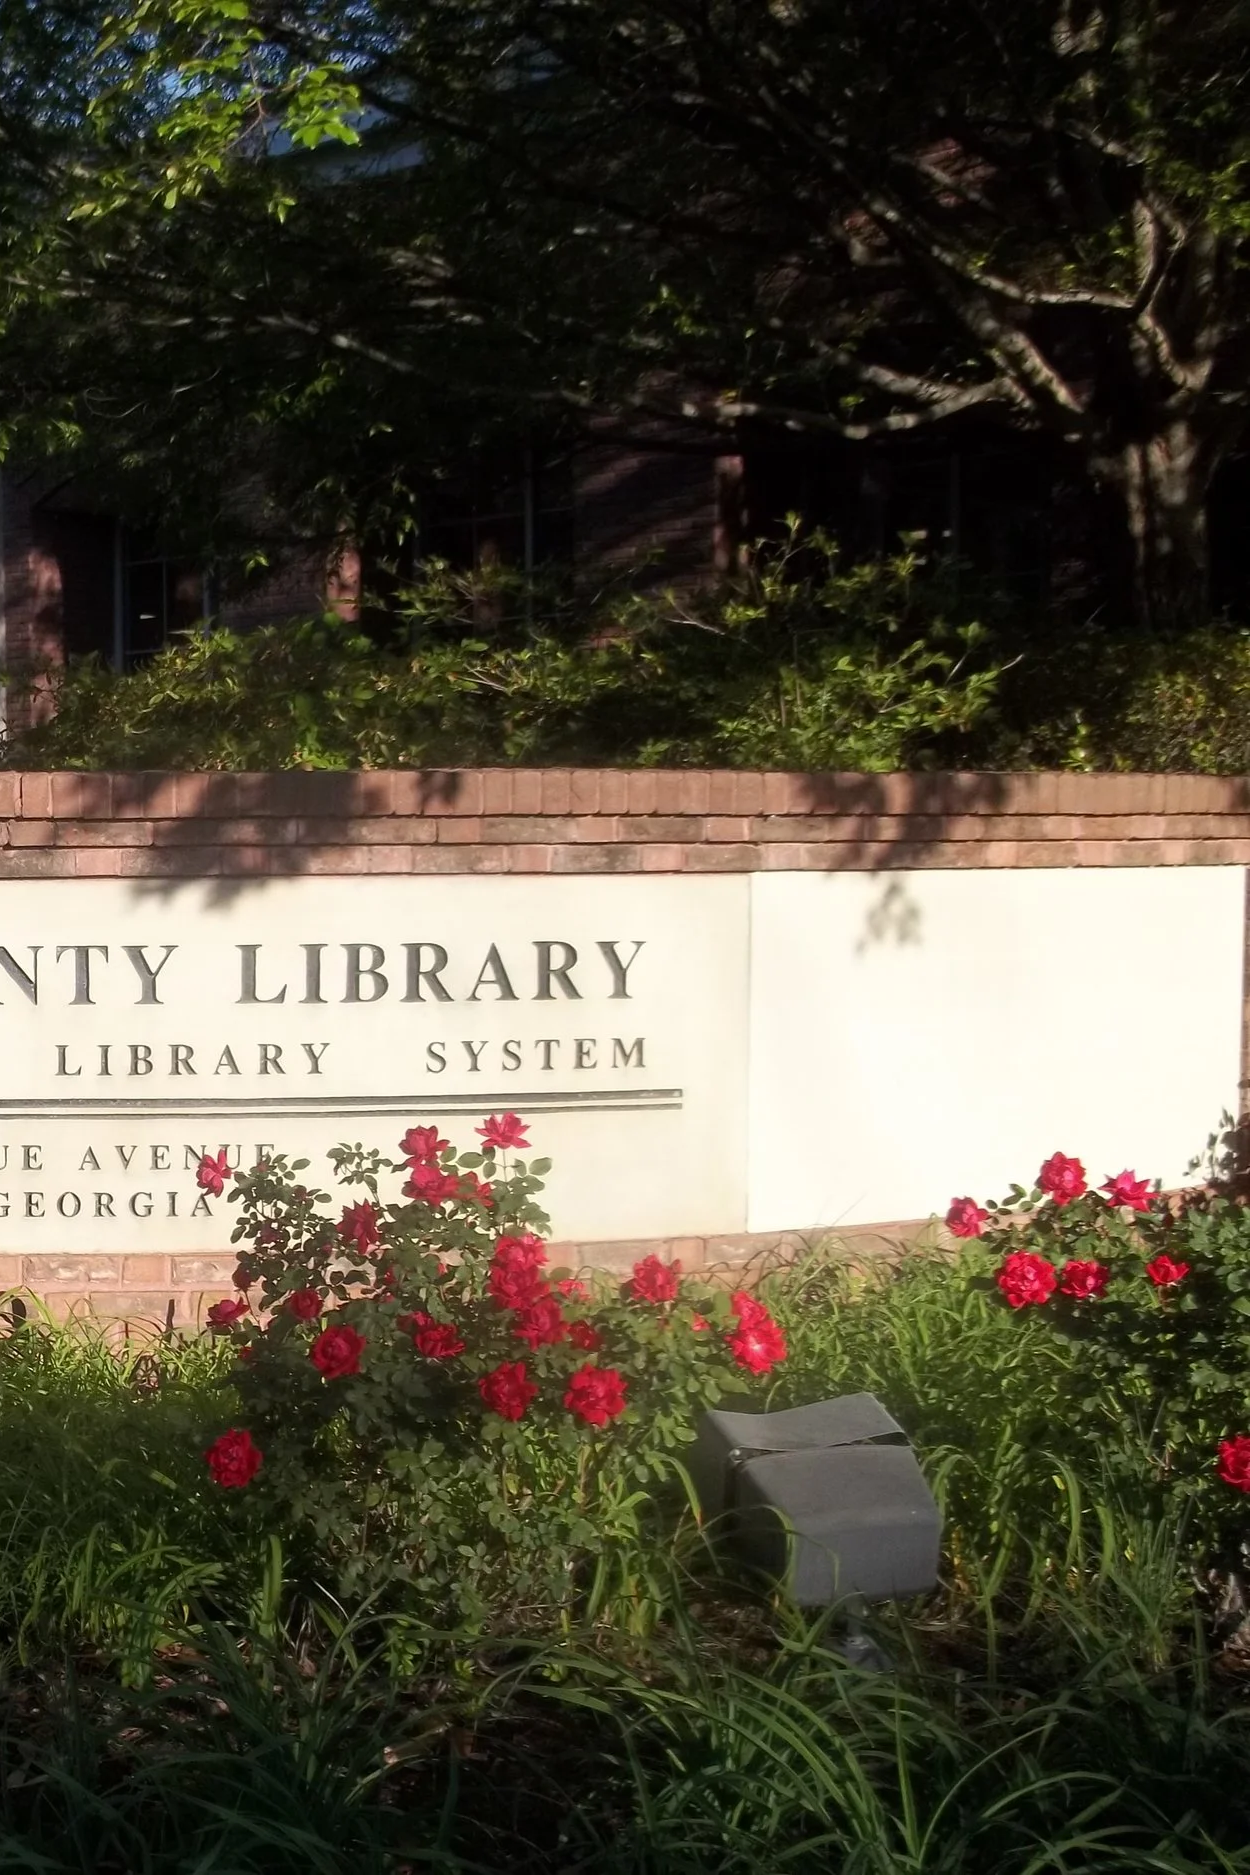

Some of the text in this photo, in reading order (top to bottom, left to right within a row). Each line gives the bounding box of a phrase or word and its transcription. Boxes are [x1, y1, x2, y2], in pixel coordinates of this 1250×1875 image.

[235, 941, 647, 1004] LIBRARY
[55, 1043, 330, 1077] LIBRARY
[427, 1038, 646, 1073] SYSTEM
